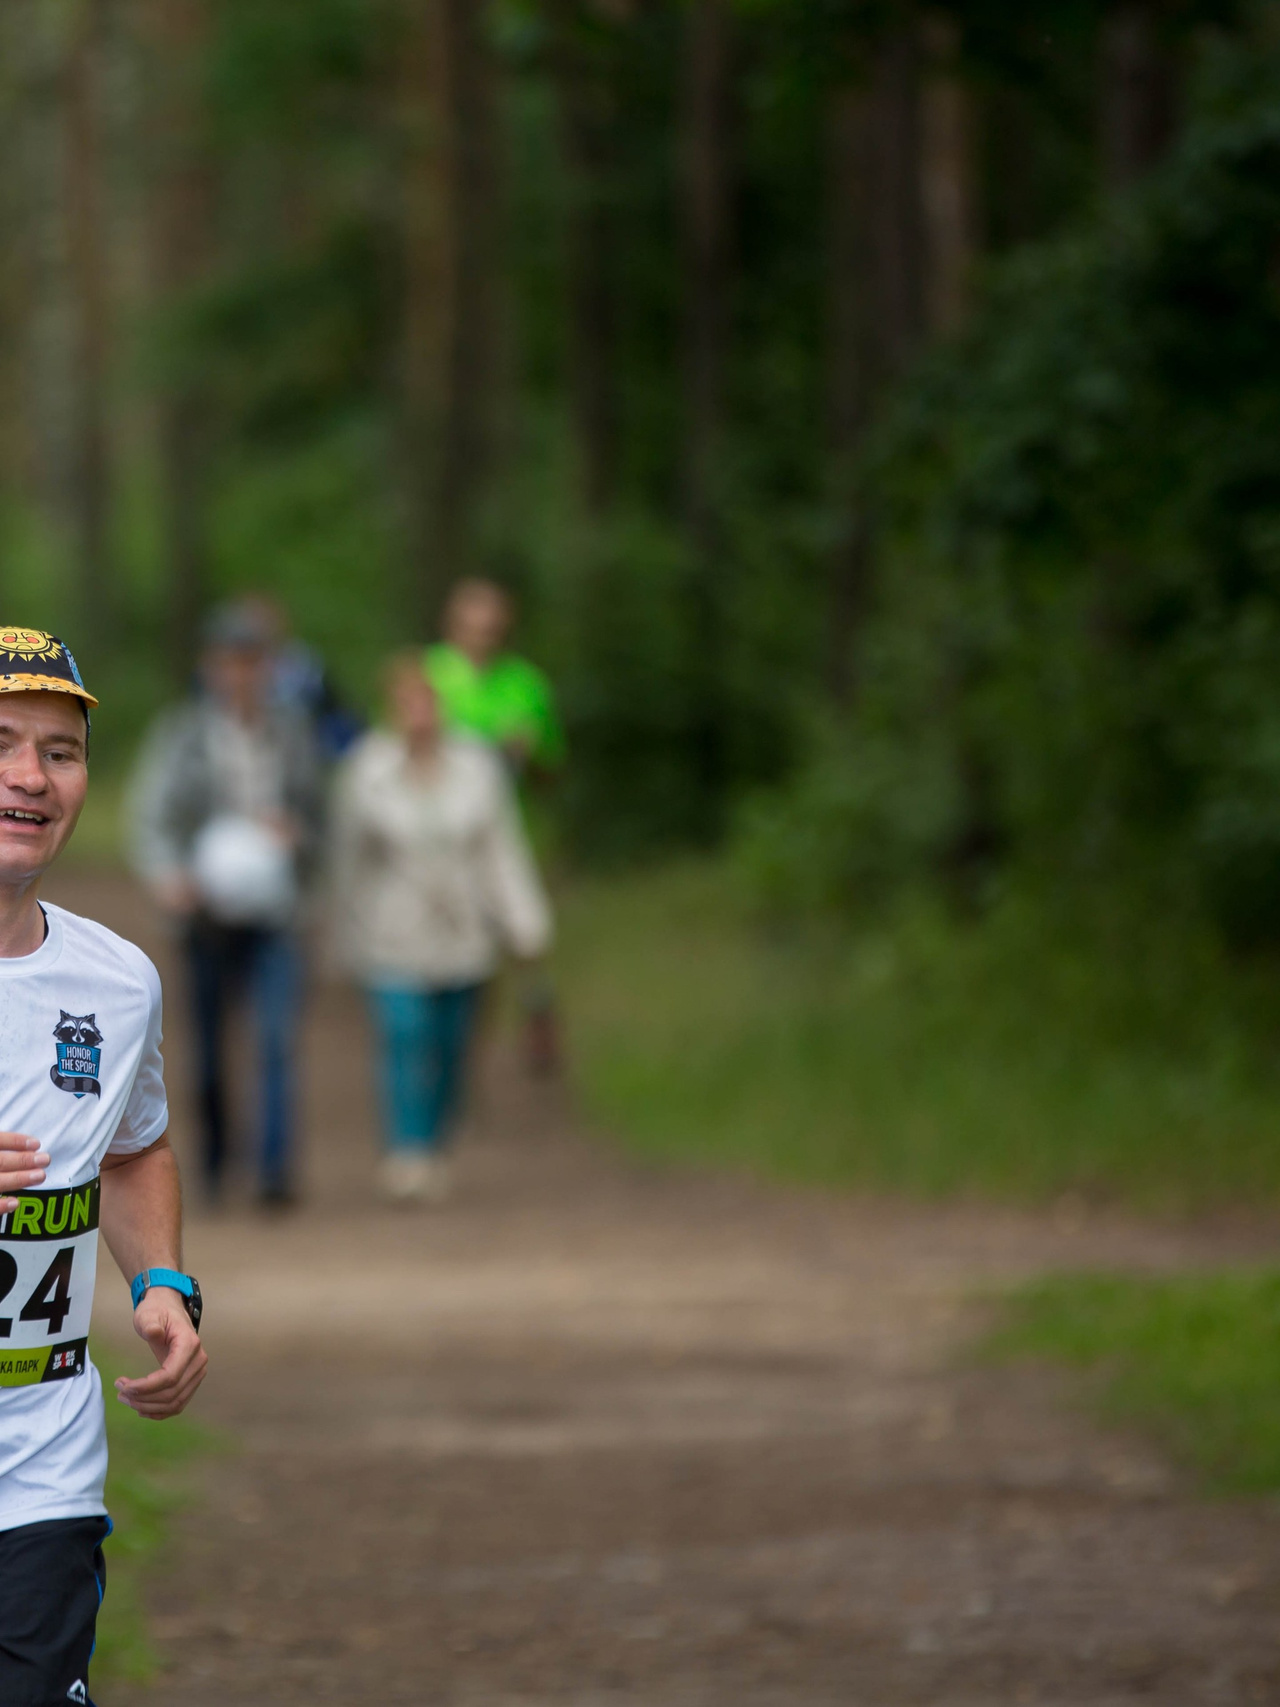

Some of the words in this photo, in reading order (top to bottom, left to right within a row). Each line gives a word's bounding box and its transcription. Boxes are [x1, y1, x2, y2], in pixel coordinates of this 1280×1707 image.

[66, 1046, 91, 1060] HONOR
[61, 1059, 74, 1071] THE
[75, 1060, 96, 1074] SPORT
[11, 1188, 91, 1235] RUN
[15, 1359, 40, 1373] ПАРК
